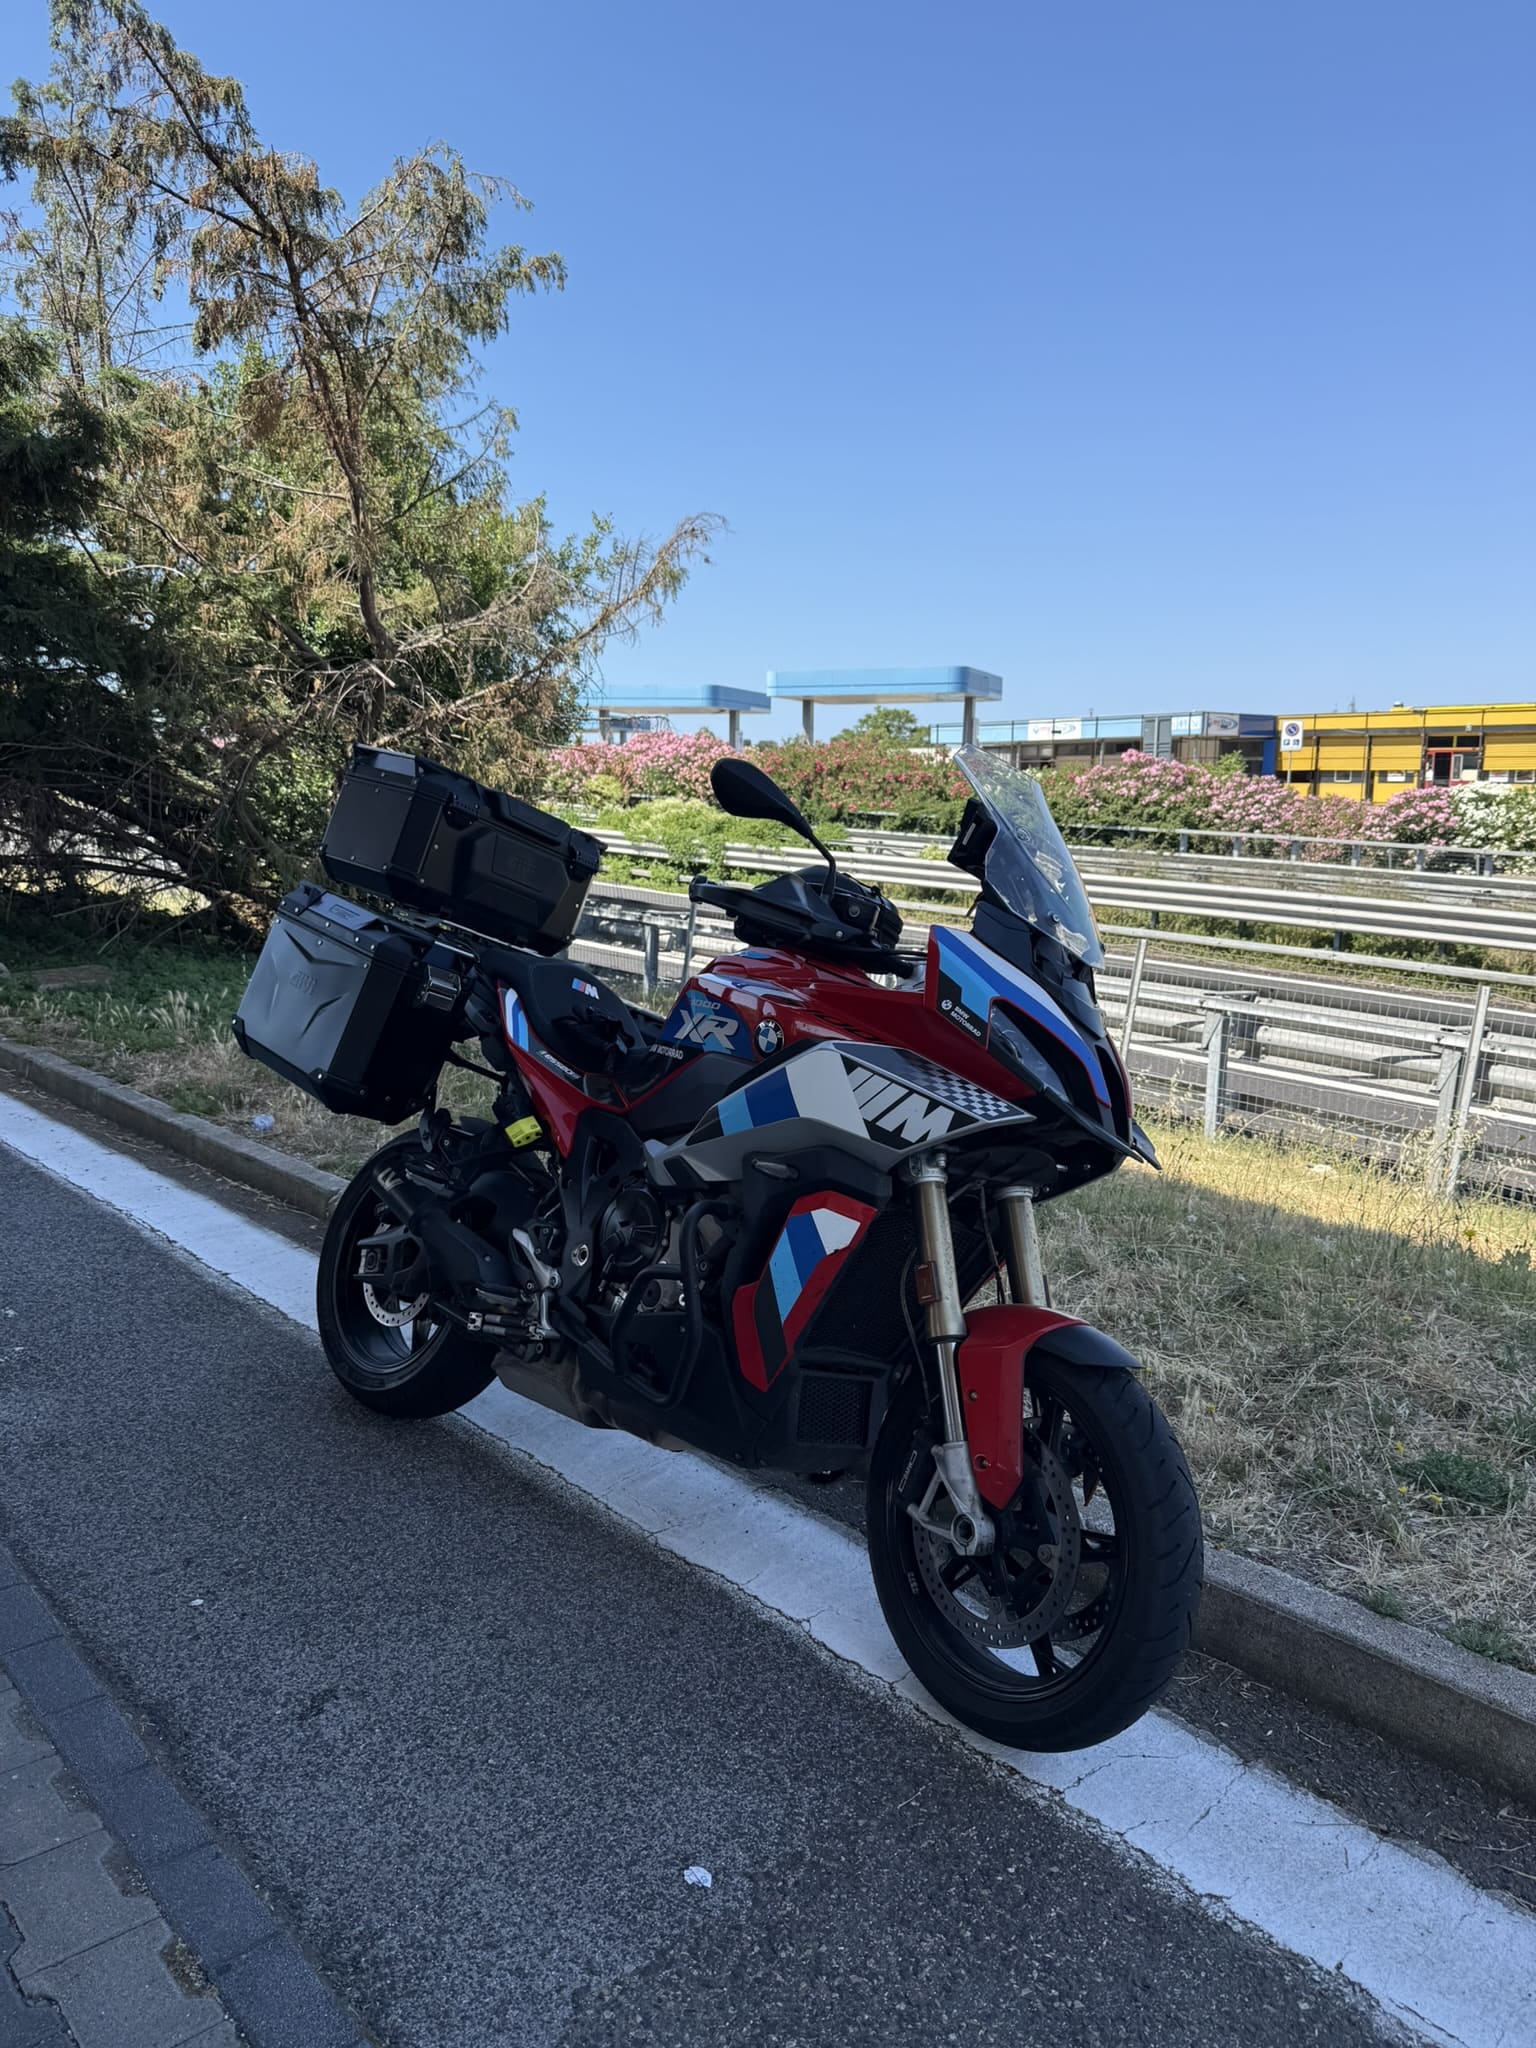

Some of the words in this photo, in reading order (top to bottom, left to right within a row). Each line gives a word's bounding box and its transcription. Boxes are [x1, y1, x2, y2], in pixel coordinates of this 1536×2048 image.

[950, 1010, 982, 1037] MOTORRAD
[953, 1005, 971, 1021] BMW
[673, 1009, 739, 1051] XR
